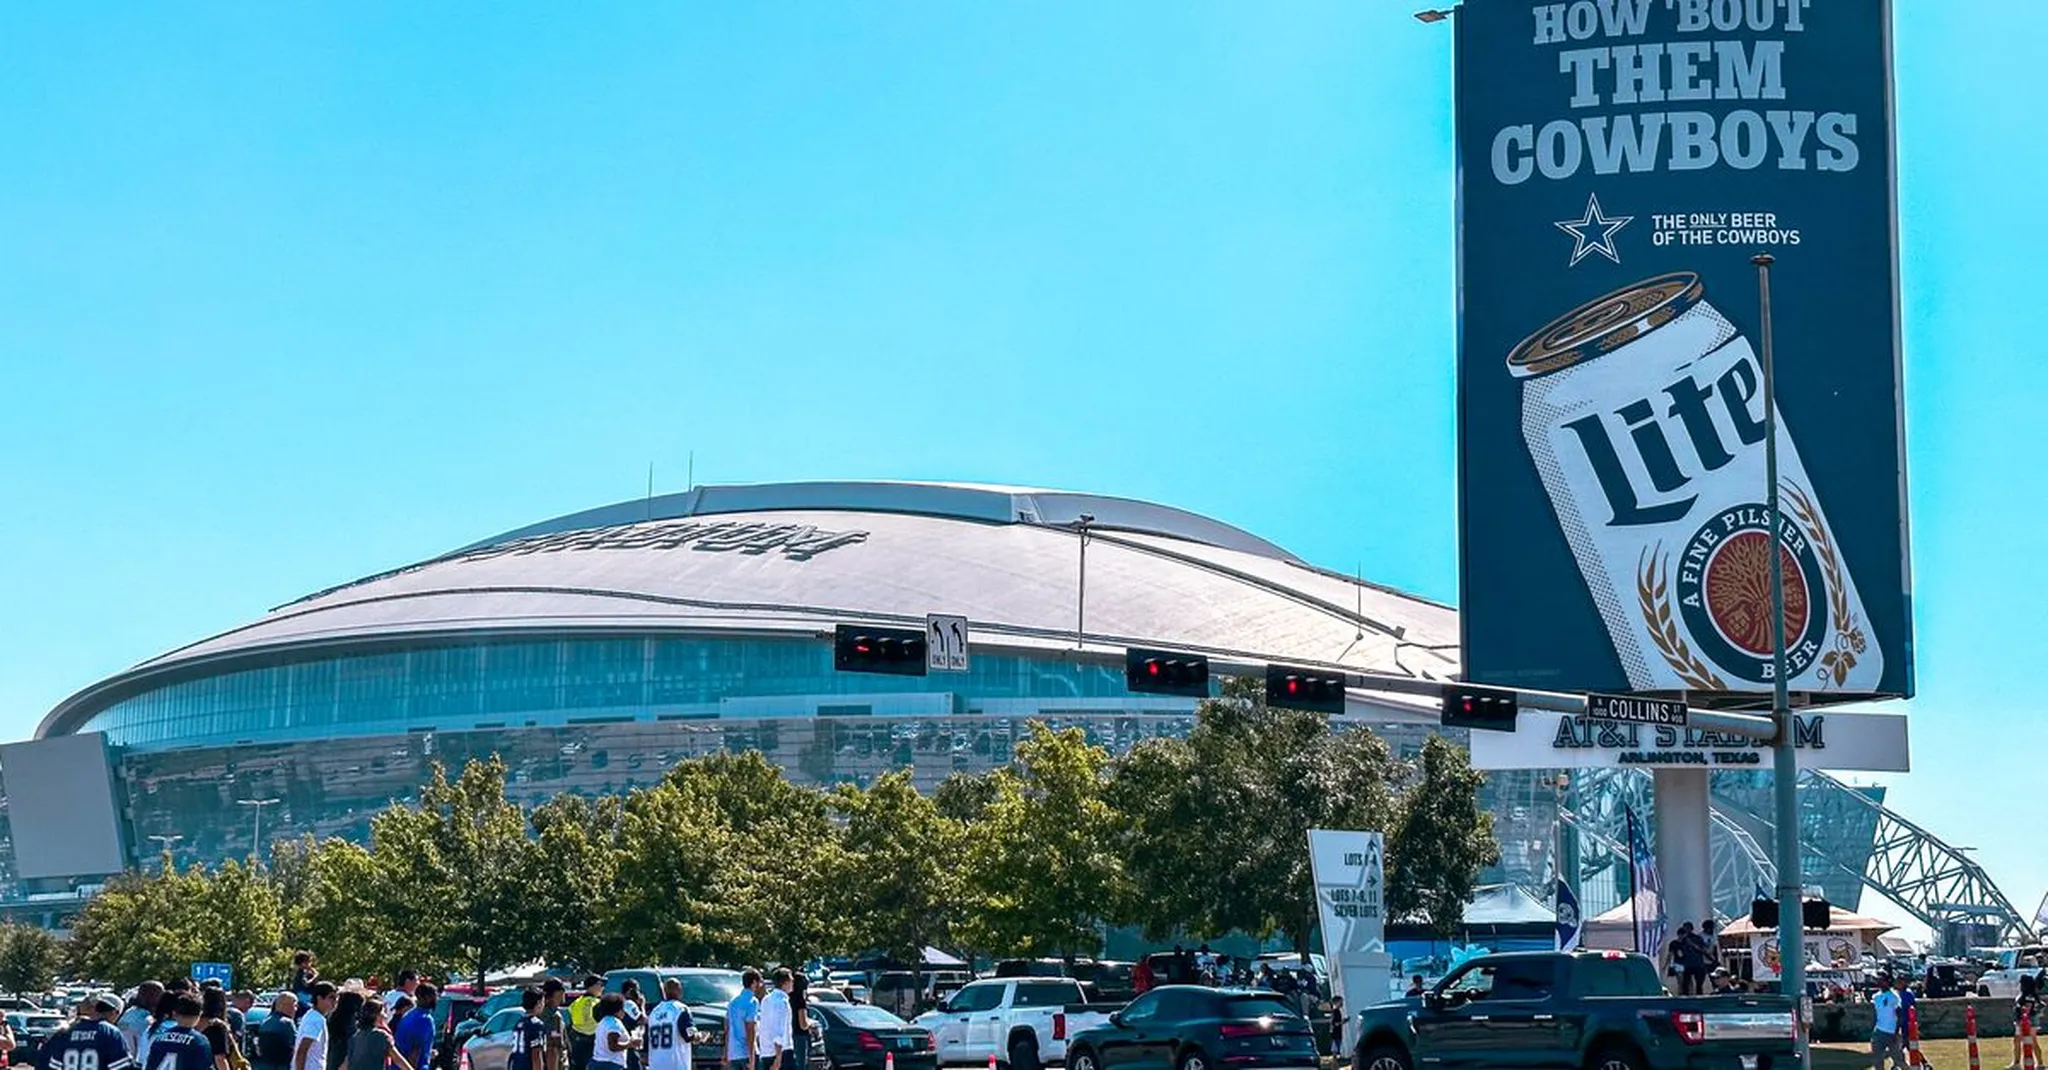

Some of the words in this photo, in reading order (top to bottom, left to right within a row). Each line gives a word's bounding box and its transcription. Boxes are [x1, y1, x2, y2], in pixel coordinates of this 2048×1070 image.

[1532, 0, 1650, 45] HOW
[1665, 0, 1810, 32] 'BOUT
[1559, 40, 1787, 108] THEM
[1491, 110, 1859, 185] COWBOYS
[1652, 214, 1687, 229] THE
[1689, 213, 1727, 226] ONLY
[1731, 213, 1776, 228] BEER
[1652, 231, 1675, 246] OF
[1679, 230, 1713, 245] THE
[1717, 229, 1800, 245] COWBOYS
[1560, 357, 1768, 526] Lite
[1682, 528, 1719, 585] FINE
[1683, 593, 1700, 608] A
[1609, 699, 1669, 722] COLLINS
[1673, 704, 1681, 713] ST
[1553, 715, 1642, 748] AT&T
[1618, 752, 1708, 764] ARLINGTON,
[1713, 752, 1760, 764] TEXAS
[1344, 853, 1362, 866] LOTS
[1331, 889, 1350, 902] LOTS
[1360, 905, 1378, 918] LOTS
[63, 1048, 100, 1070] 88
